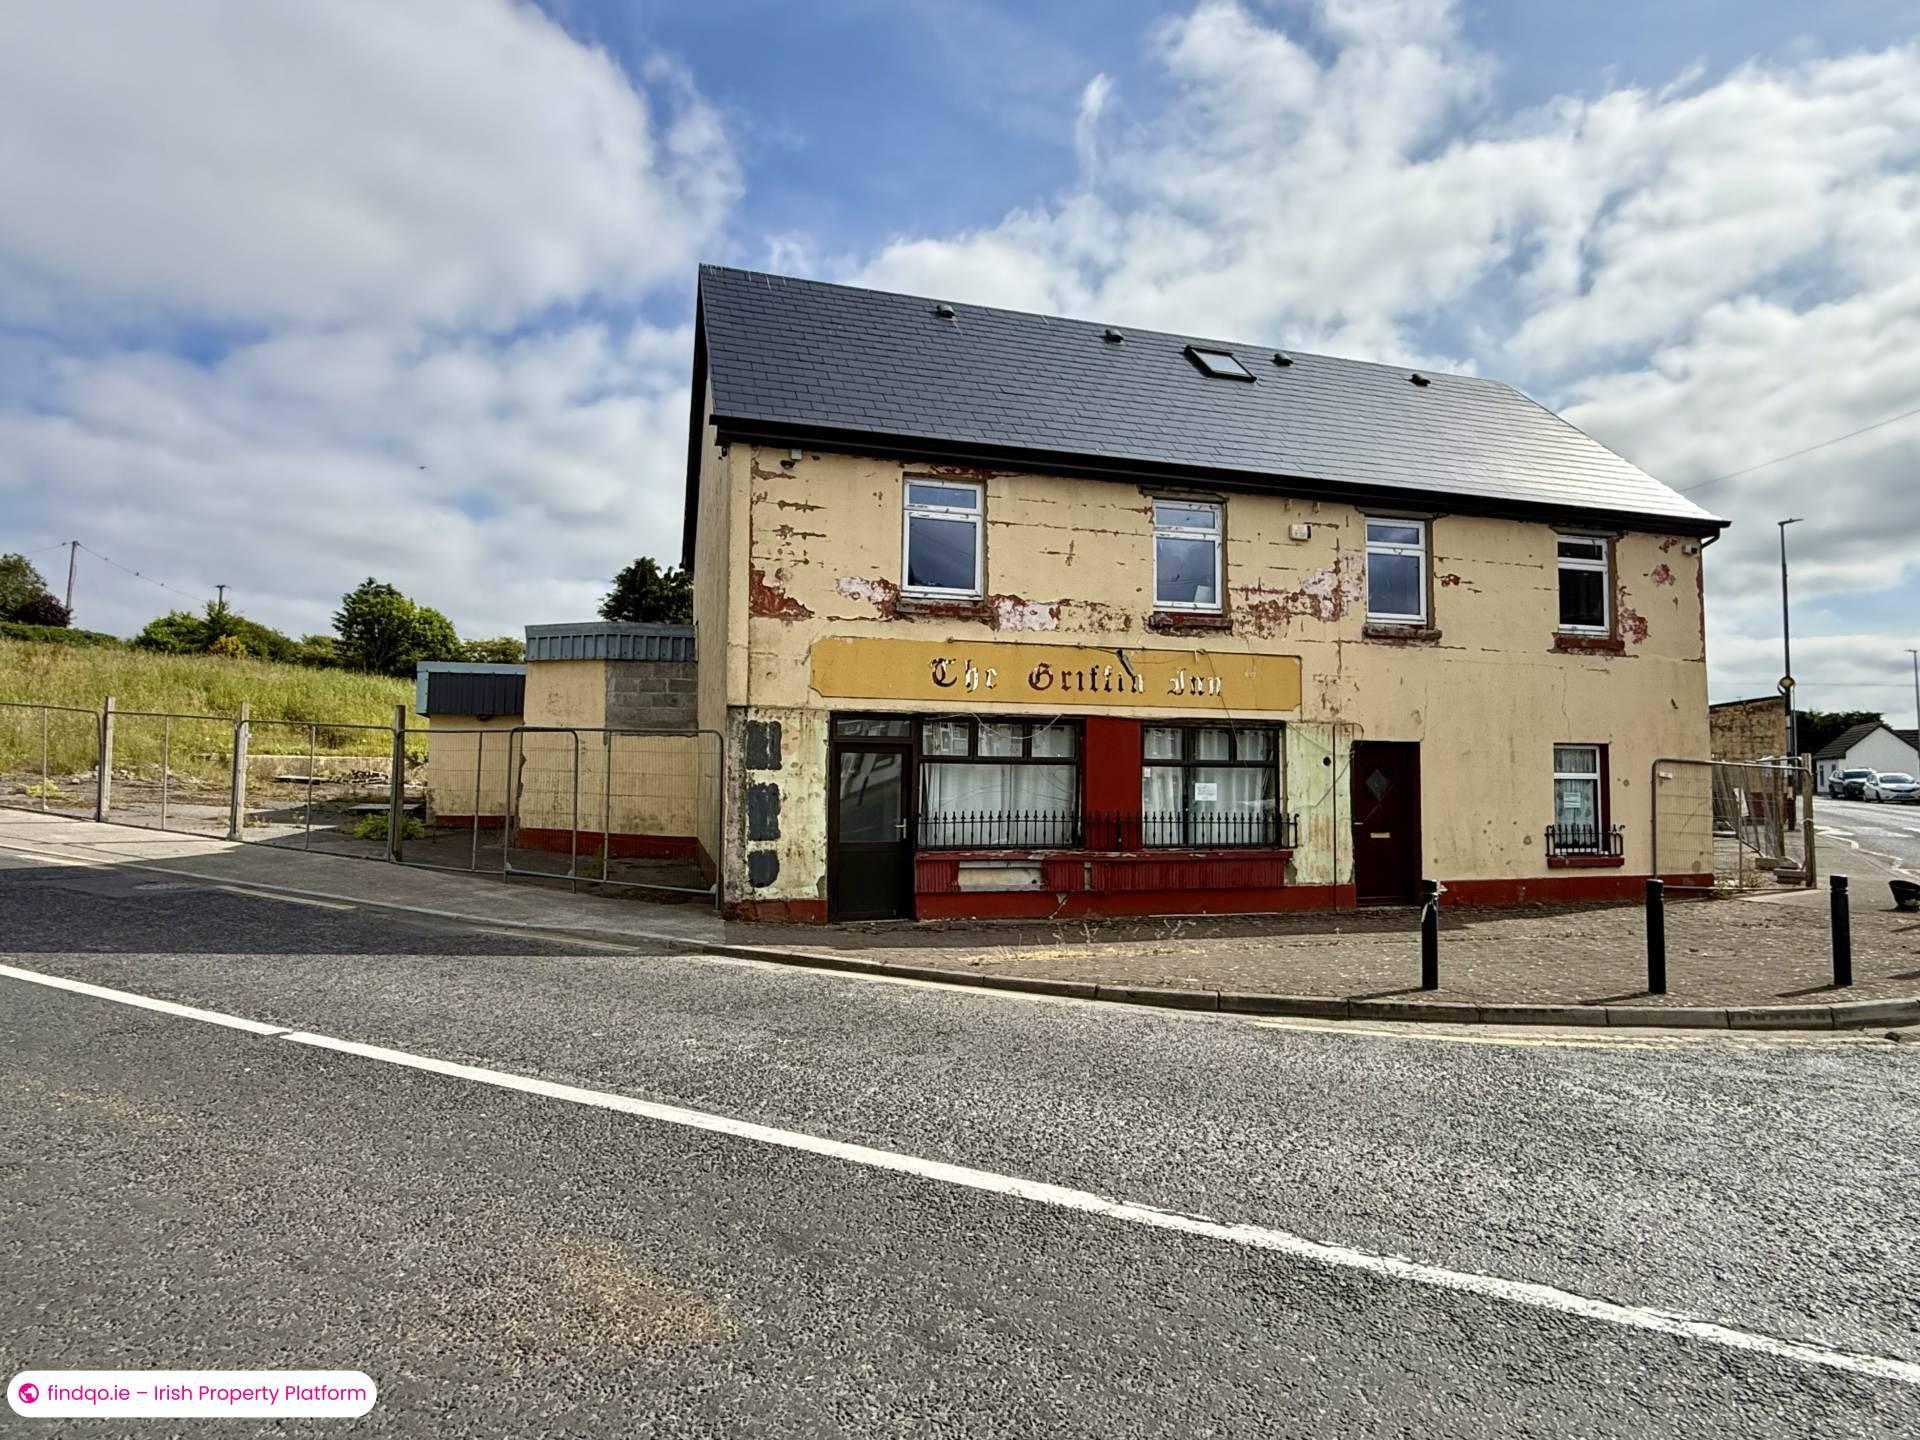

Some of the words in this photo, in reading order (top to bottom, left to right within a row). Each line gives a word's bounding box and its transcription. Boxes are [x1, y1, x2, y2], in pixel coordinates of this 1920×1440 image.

[928, 657, 998, 693] The
[1028, 662, 1144, 695] Griffin
[1166, 667, 1222, 697] Inn
